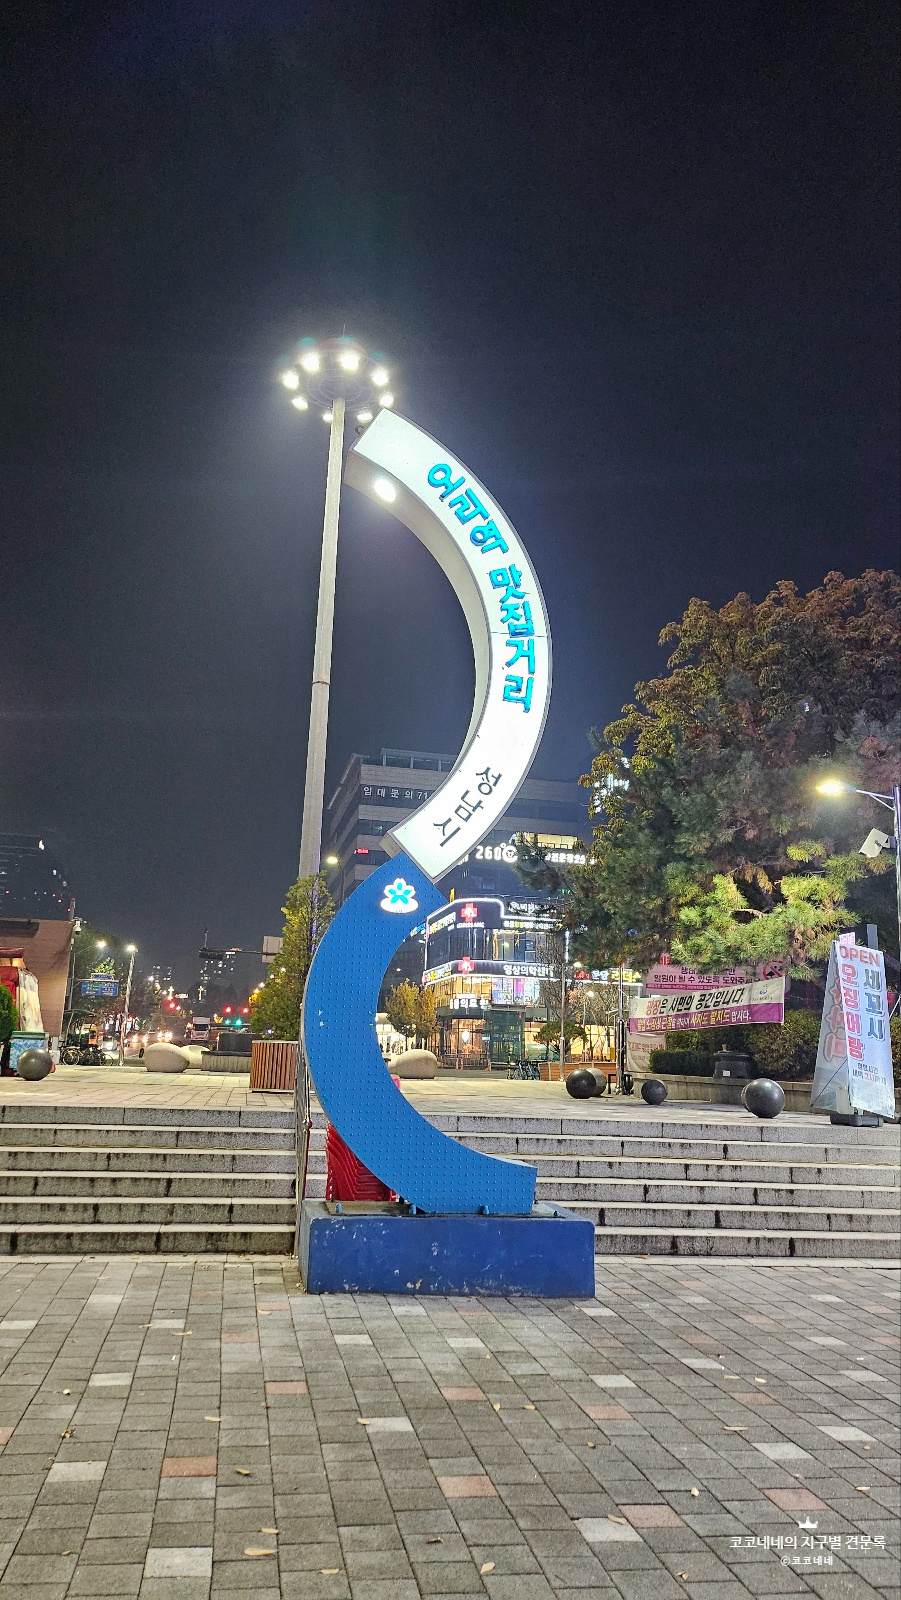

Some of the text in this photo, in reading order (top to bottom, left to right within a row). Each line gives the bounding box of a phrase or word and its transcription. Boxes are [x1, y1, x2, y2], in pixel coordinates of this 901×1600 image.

[428, 464, 535, 712] 오리역 맛집거리
[363, 786, 413, 800] 임대문의
[433, 766, 502, 847] 성남시
[838, 945, 881, 967] OPEN
[698, 975, 720, 984] 있도록
[645, 987, 745, 1016] 광장은 시민의 공간입니다.
[841, 963, 864, 1061] 오징어랑
[863, 968, 885, 1041] 세꼬시
[690, 1011, 709, 1026] 사지도
[710, 1009, 730, 1024] 팔지도
